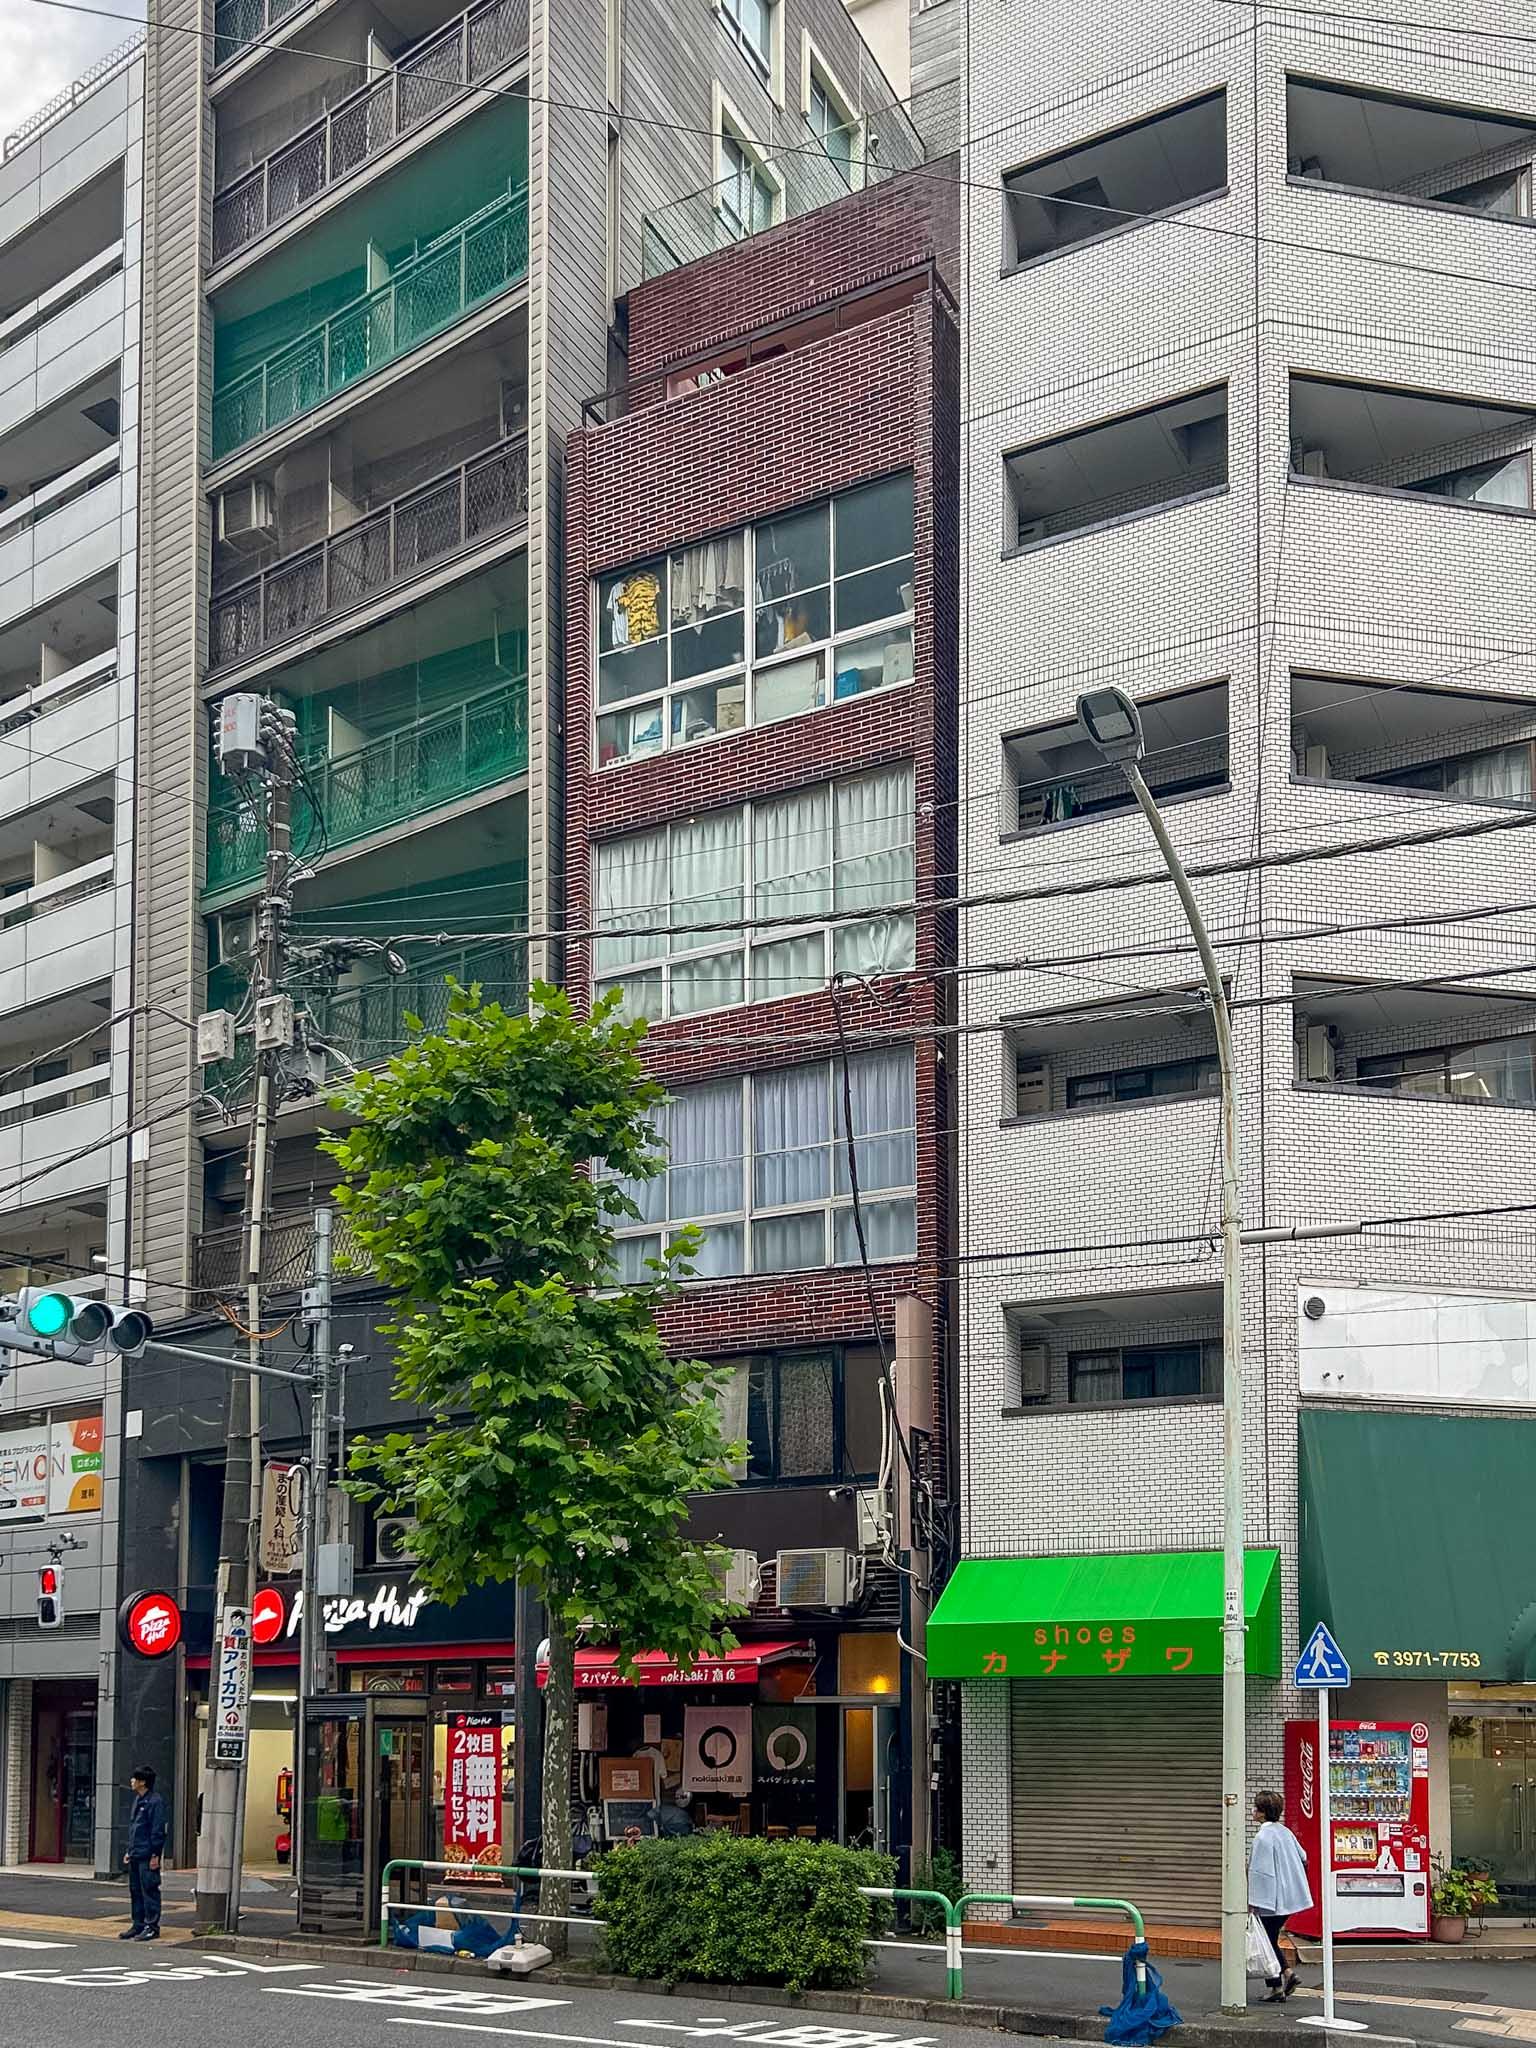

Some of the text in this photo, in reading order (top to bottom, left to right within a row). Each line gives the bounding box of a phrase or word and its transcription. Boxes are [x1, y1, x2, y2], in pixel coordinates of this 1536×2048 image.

[0, 1453, 65, 1484] EMON
[77, 1457, 101, 1468] ロボット
[367, 1585, 428, 1629] Hut
[140, 1617, 170, 1640] Pizza
[146, 1627, 168, 1645] Hut
[1034, 1625, 1136, 1645] shoes
[983, 1647, 1193, 1674] カナザワ
[1393, 1652, 1481, 1667] 3971-7753
[221, 1650, 239, 1709] アイカワ
[454, 1730, 494, 1754] 2枚目
[465, 1755, 497, 1843] 無料
